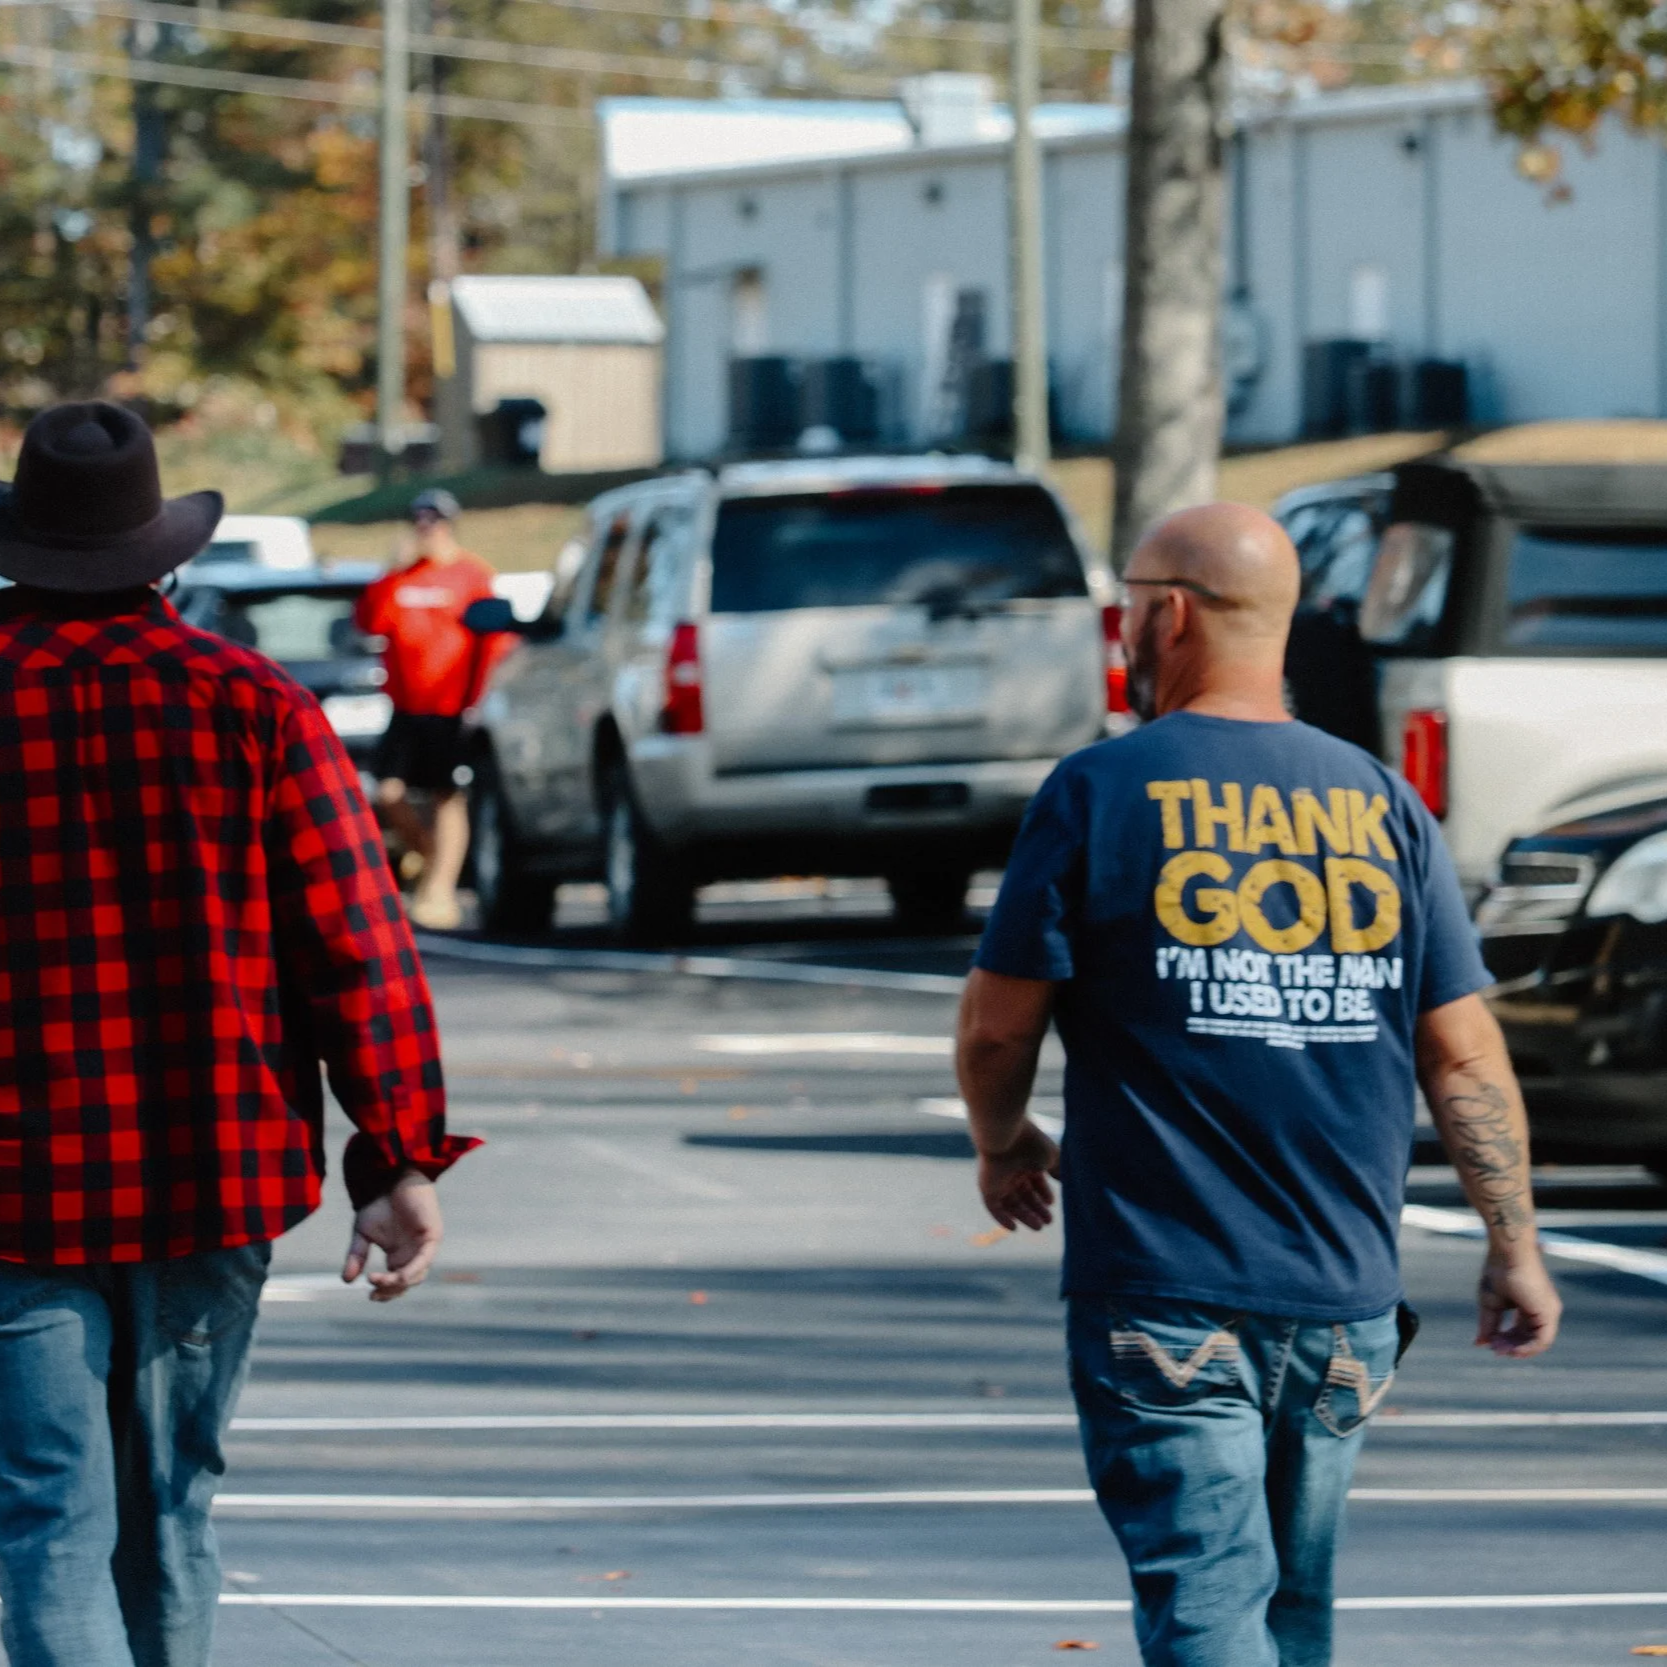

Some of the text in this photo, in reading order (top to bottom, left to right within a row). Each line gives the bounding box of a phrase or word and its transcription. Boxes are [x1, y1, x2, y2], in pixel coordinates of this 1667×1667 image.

[1146, 778, 1398, 860] THANK
[1154, 851, 1401, 954] GOD
[1211, 949, 1272, 984] NOT
[1274, 954, 1335, 987] THE
[1338, 957, 1403, 989] MAN
[1190, 980, 1203, 1012] I
[1209, 982, 1283, 1017] USED
[1284, 988, 1331, 1021] TO
